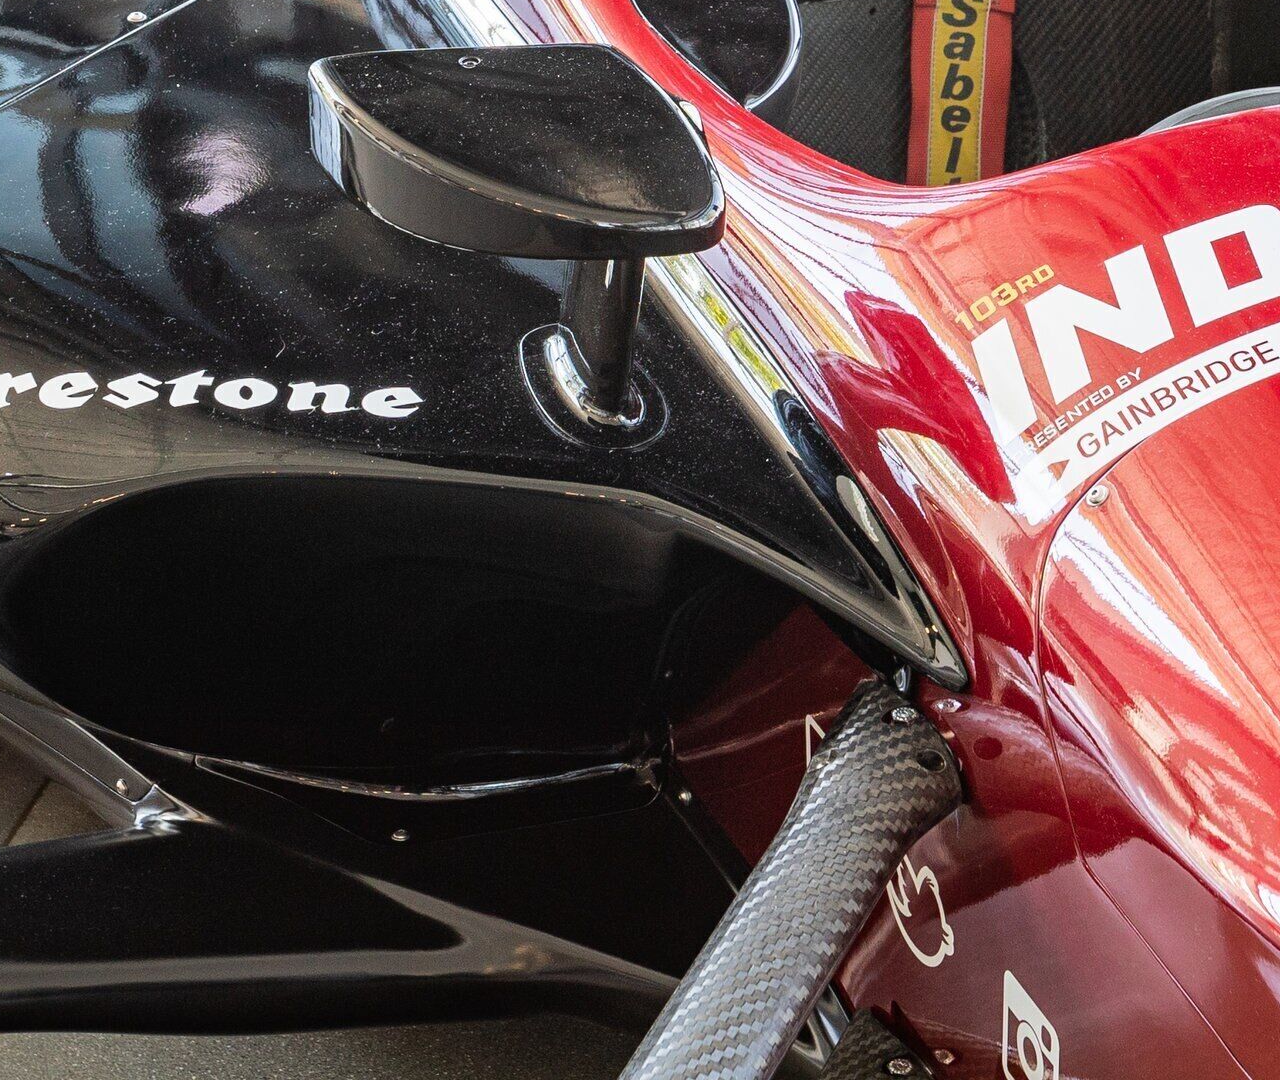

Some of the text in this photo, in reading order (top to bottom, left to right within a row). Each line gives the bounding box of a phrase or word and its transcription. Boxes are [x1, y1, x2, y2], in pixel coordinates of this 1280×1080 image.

[954, 263, 1055, 331] 103RD
[1075, 340, 1280, 459] GAINBRIDGE
[1116, 366, 1142, 389] BY
